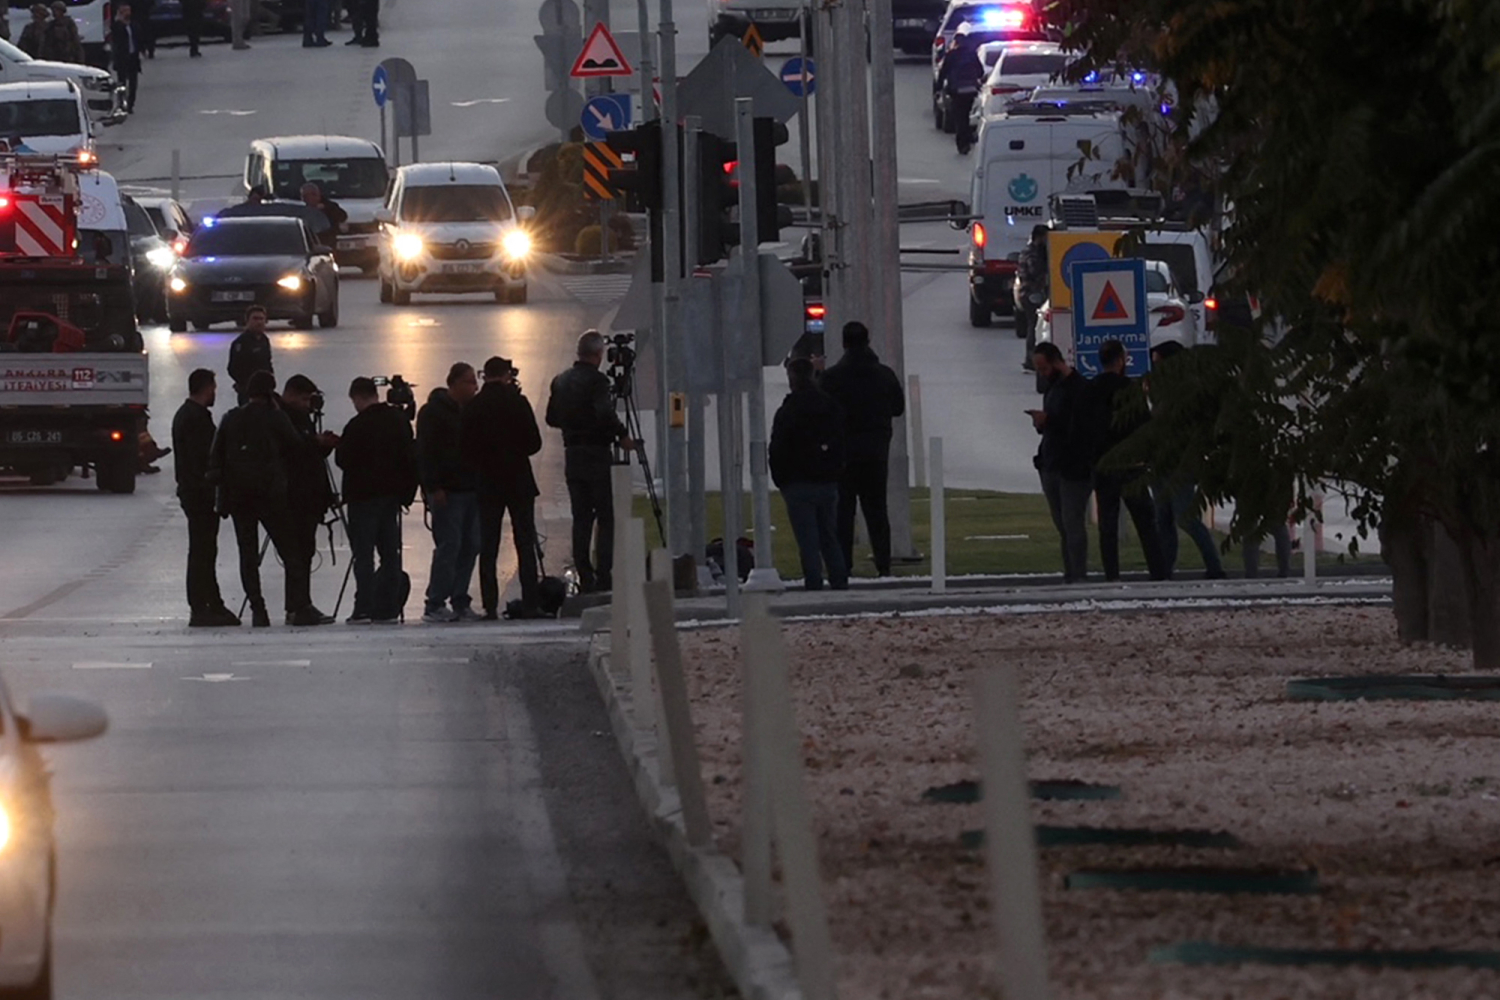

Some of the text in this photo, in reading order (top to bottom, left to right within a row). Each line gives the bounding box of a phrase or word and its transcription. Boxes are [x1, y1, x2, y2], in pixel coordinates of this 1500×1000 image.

[1004, 206, 1043, 216] UMKE
[4, 369, 66, 378] ANKARA
[74, 370, 92, 380] 112
